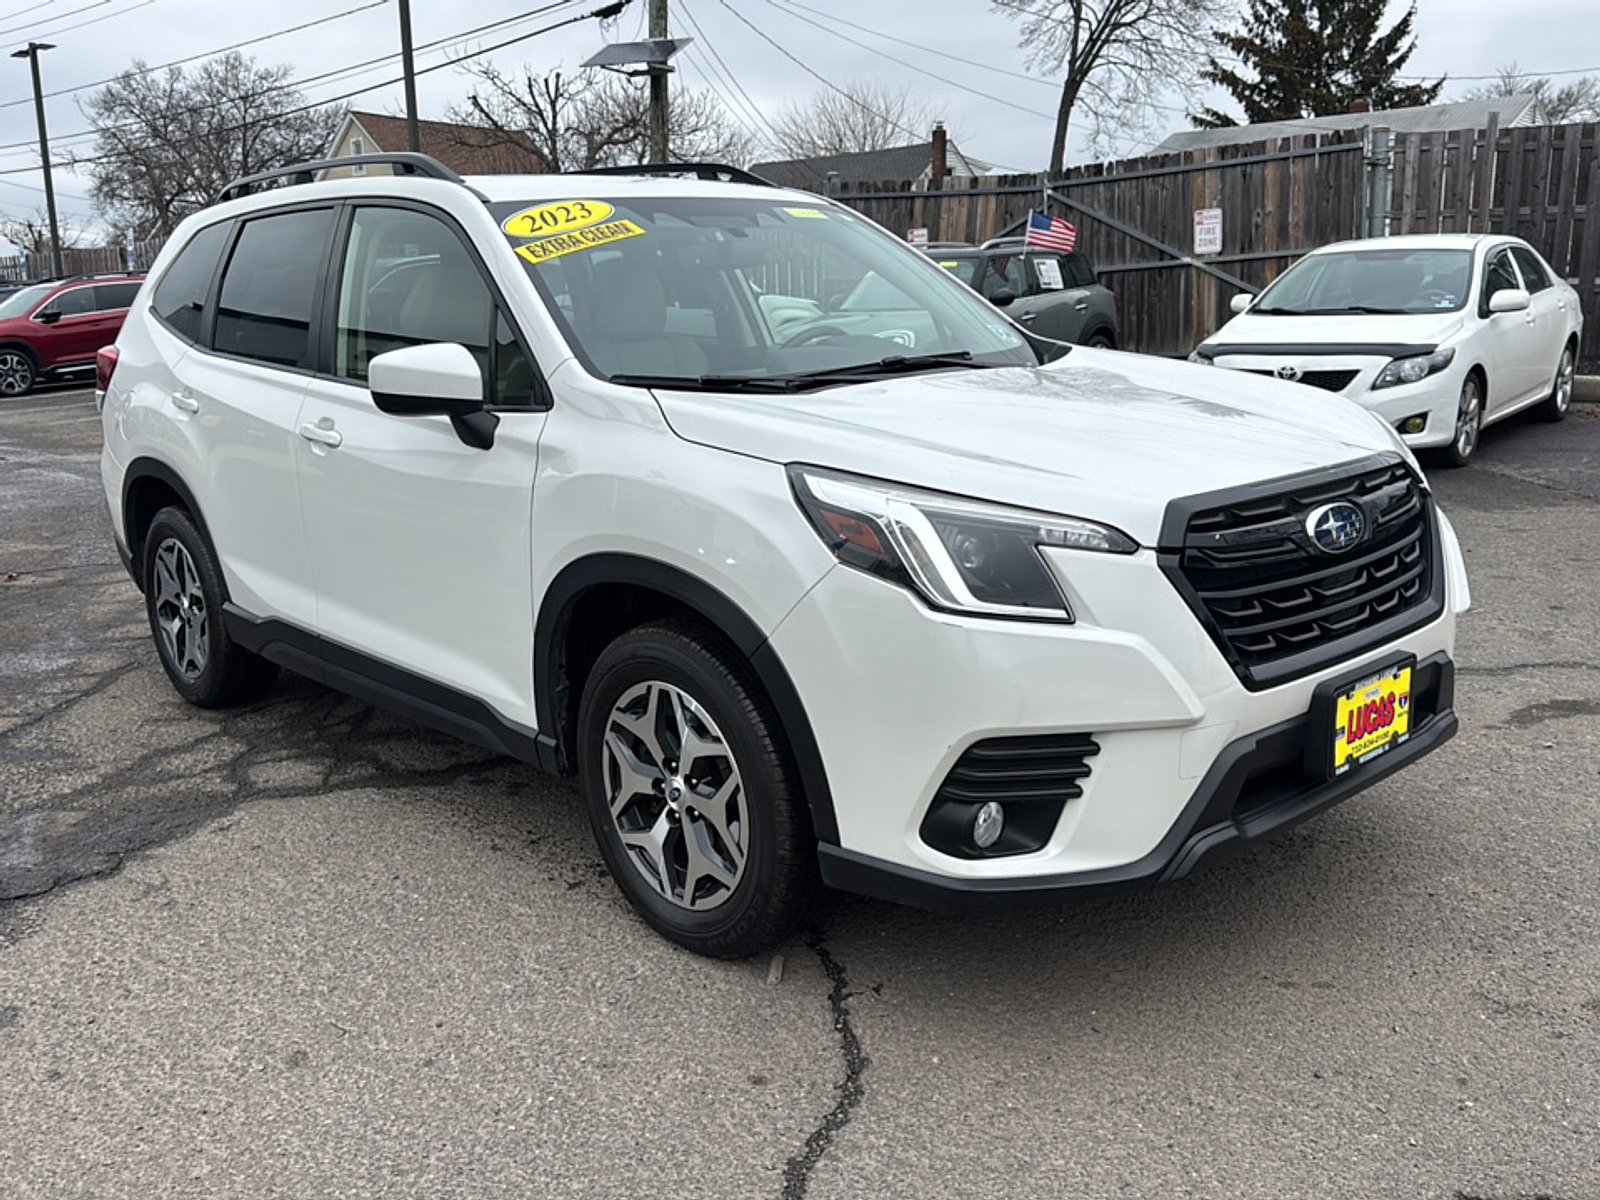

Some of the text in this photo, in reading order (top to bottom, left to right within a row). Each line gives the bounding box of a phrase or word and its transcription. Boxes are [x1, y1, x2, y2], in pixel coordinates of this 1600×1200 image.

[521, 201, 592, 233] 2023
[1199, 226, 1217, 237] FIRE
[525, 221, 636, 258] EXTRA CLEAN
[1198, 237, 1218, 248] ZONE
[1346, 691, 1397, 745] LUCAS
